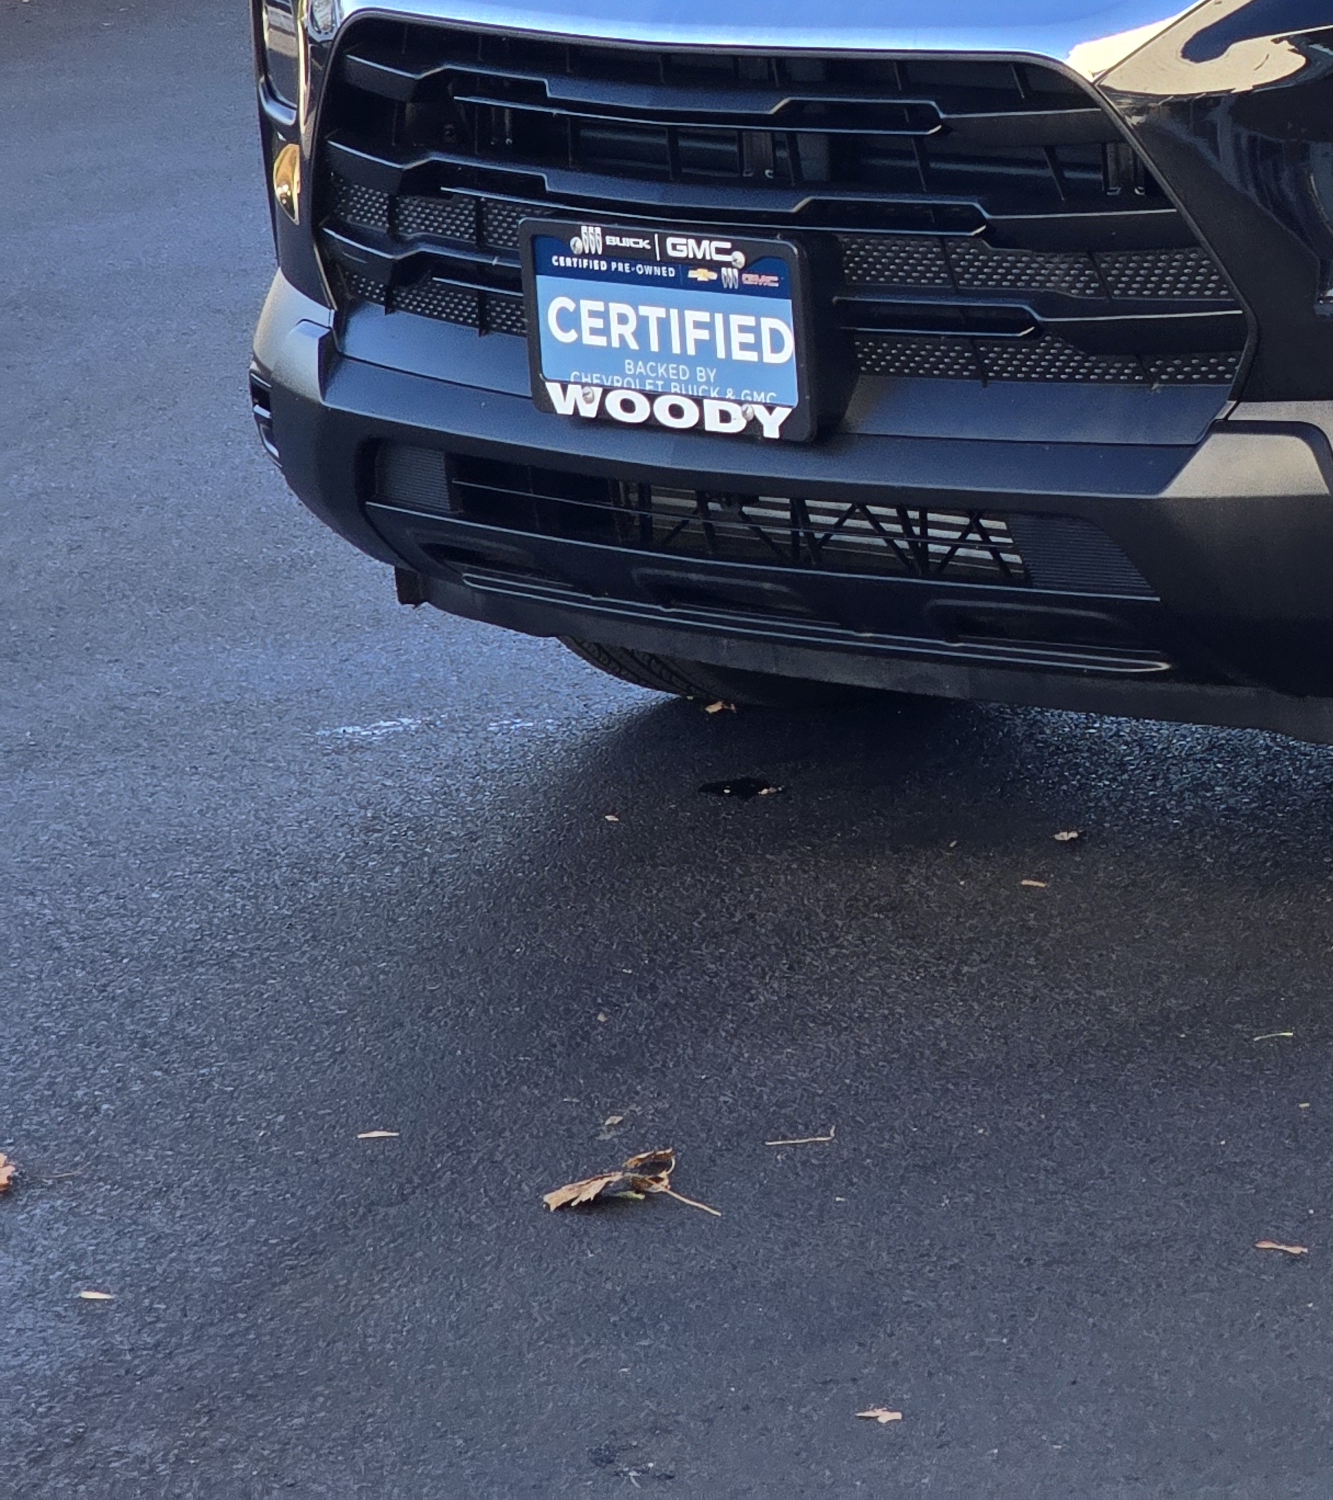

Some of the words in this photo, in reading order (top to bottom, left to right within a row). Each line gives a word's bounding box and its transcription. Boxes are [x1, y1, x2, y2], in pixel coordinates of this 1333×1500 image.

[605, 235, 651, 249] BUICK
[666, 237, 733, 261] GMC
[552, 255, 607, 271] CERTIFIED
[611, 261, 676, 277] PRE-OWNED
[547, 296, 795, 364] CERTIFIED
[625, 359, 690, 380] BACKED
[696, 367, 717, 383] BY
[545, 382, 793, 438] WOODY
